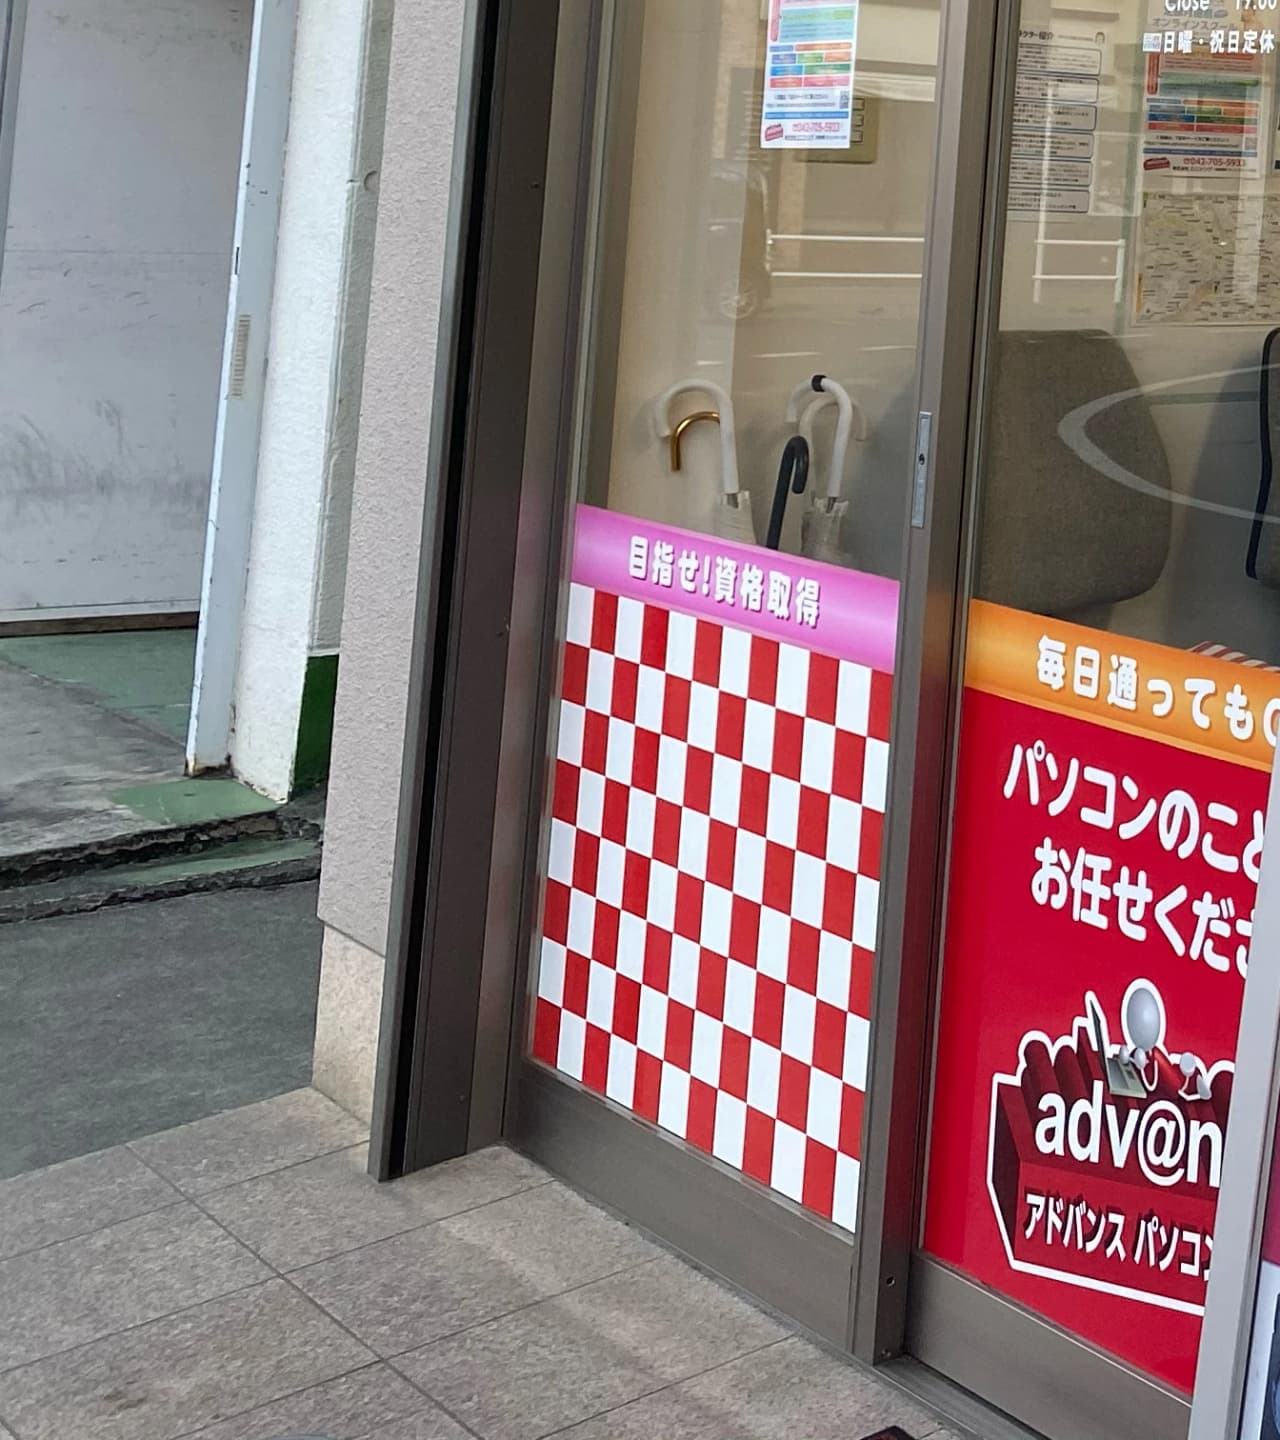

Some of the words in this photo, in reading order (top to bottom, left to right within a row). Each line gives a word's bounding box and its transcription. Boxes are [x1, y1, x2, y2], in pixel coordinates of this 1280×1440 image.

[1163, 29, 1275, 54] 日曜・祝日定休
[627, 534, 822, 629] 目指せ!資格取得
[1024, 1192, 1125, 1263] アドバンス
